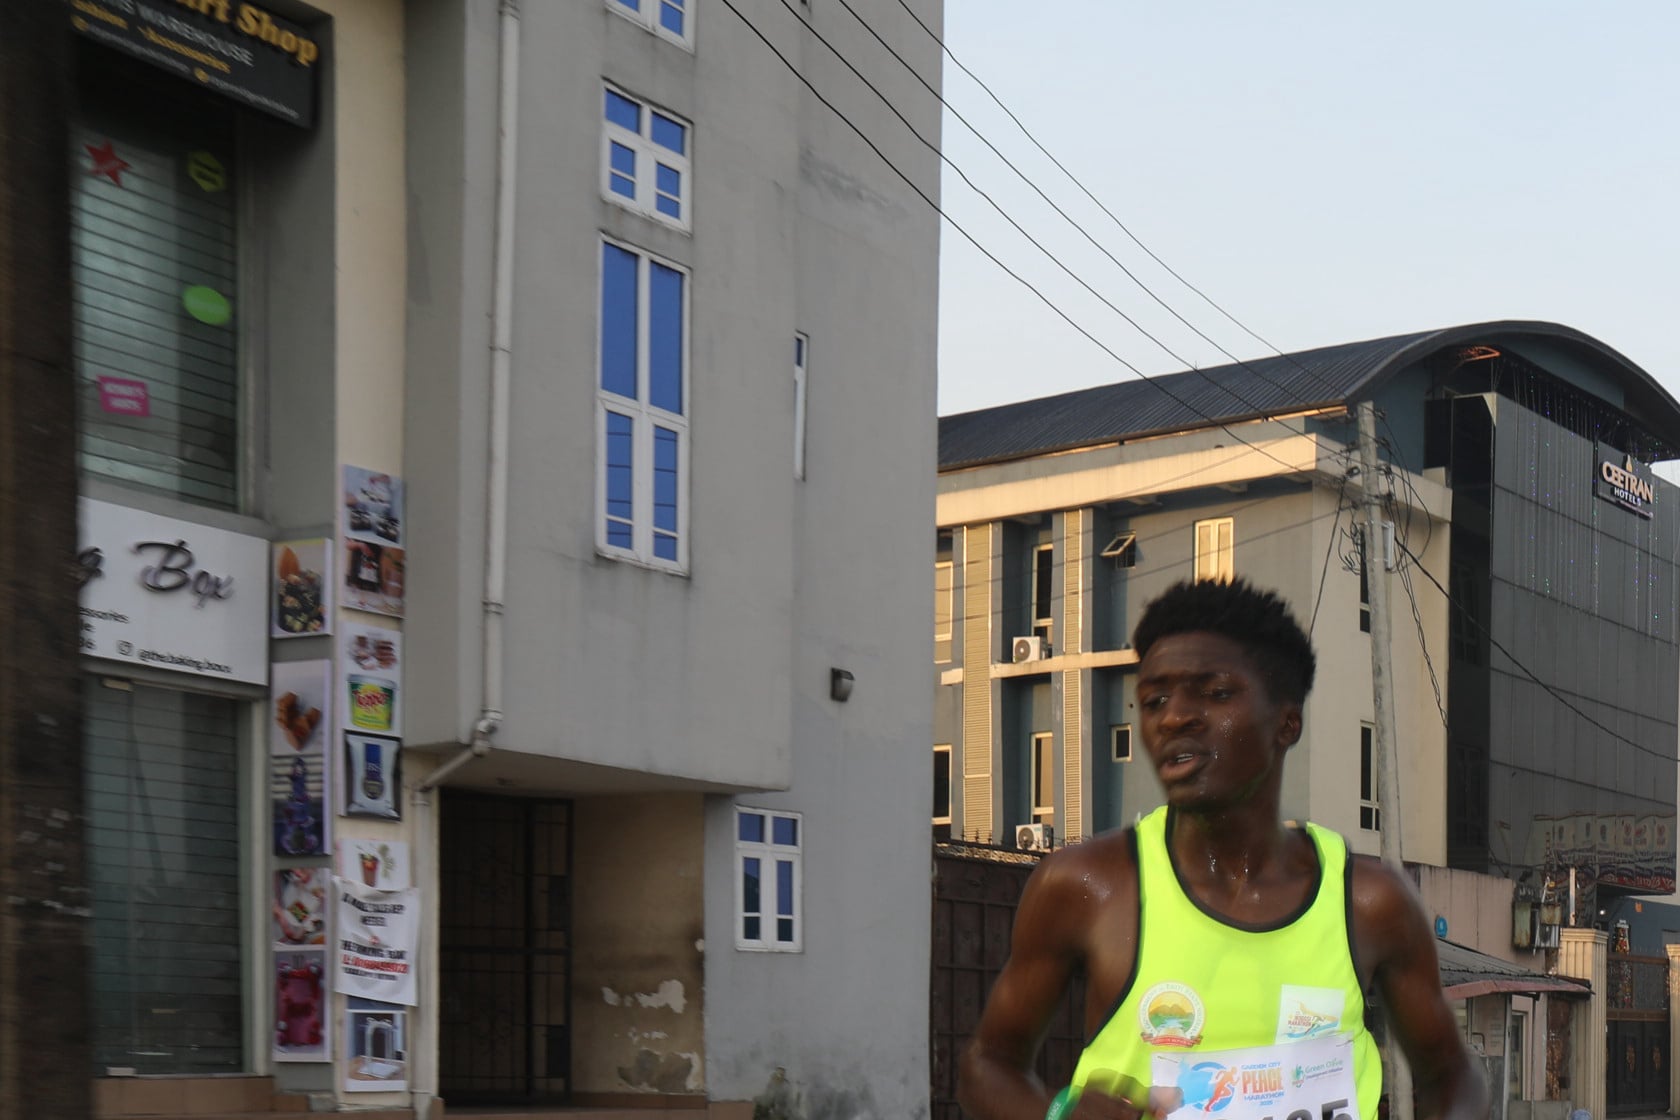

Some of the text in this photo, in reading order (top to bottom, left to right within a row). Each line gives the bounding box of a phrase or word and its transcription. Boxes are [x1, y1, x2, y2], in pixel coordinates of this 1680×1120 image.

[237, 3, 318, 67] Shop
[1602, 461, 1653, 504] CEETRAN
[1614, 487, 1641, 506] HOTELS
[1305, 1063, 1325, 1074] Green
[1242, 1067, 1284, 1094] PEACE
[1244, 1091, 1284, 1100] MARATHON
